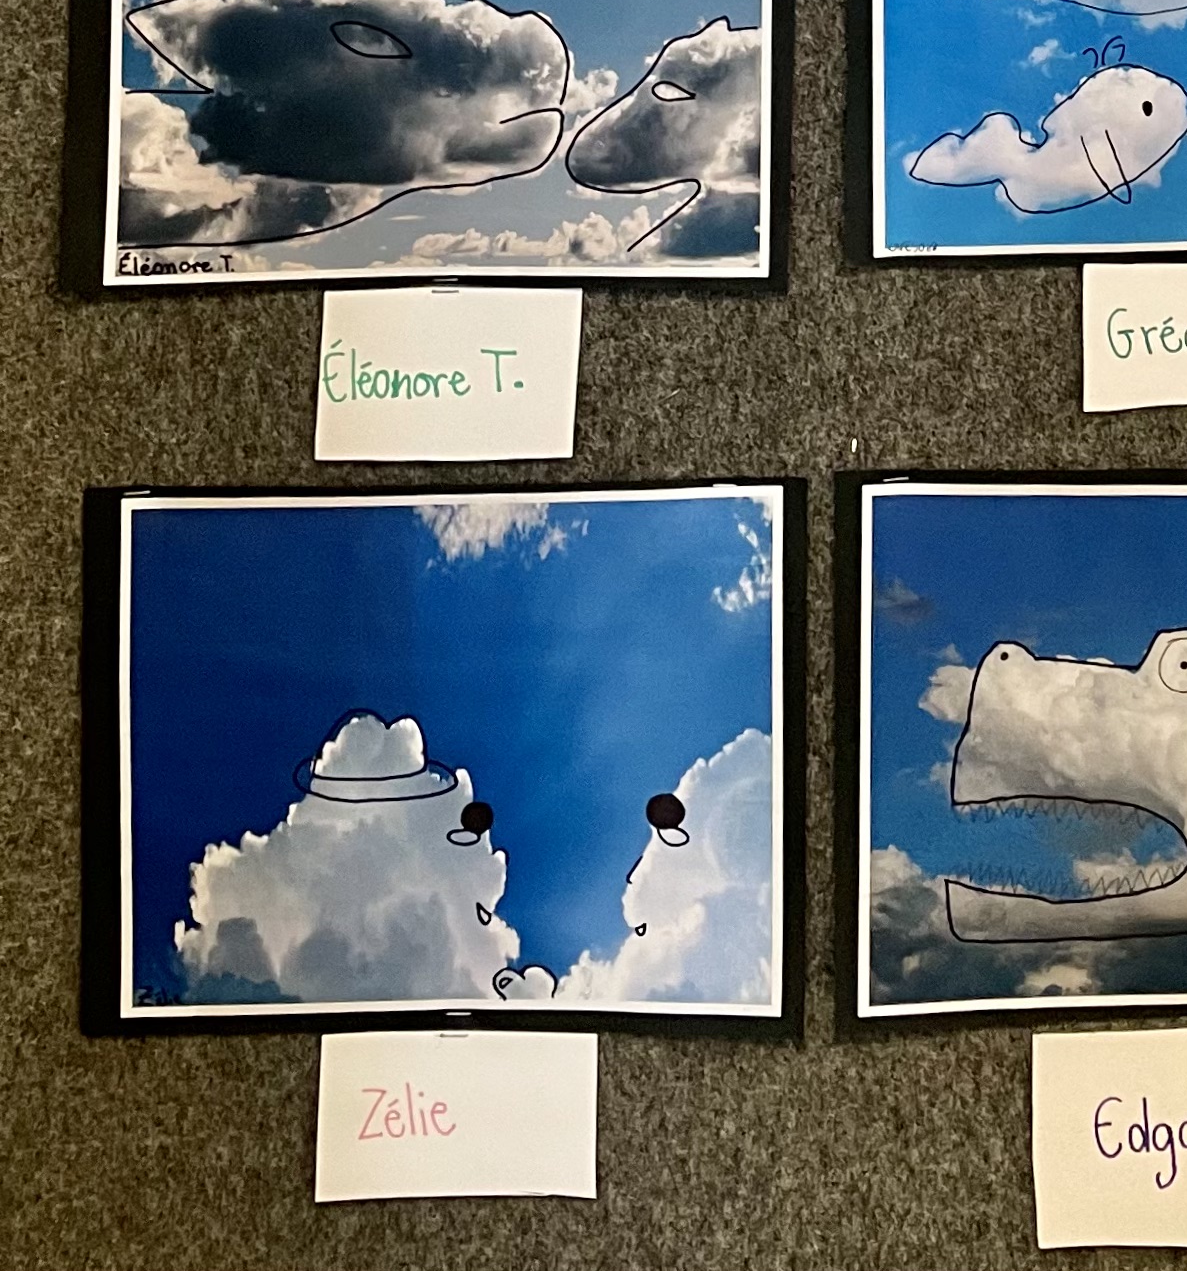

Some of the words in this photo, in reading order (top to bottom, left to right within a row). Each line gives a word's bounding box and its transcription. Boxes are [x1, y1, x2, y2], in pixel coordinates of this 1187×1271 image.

[118, 251, 213, 276] Éléonore
[219, 254, 235, 273] T.
[322, 339, 471, 403] Éléonore
[480, 348, 524, 393] T.
[358, 1082, 456, 1140] Zélie
